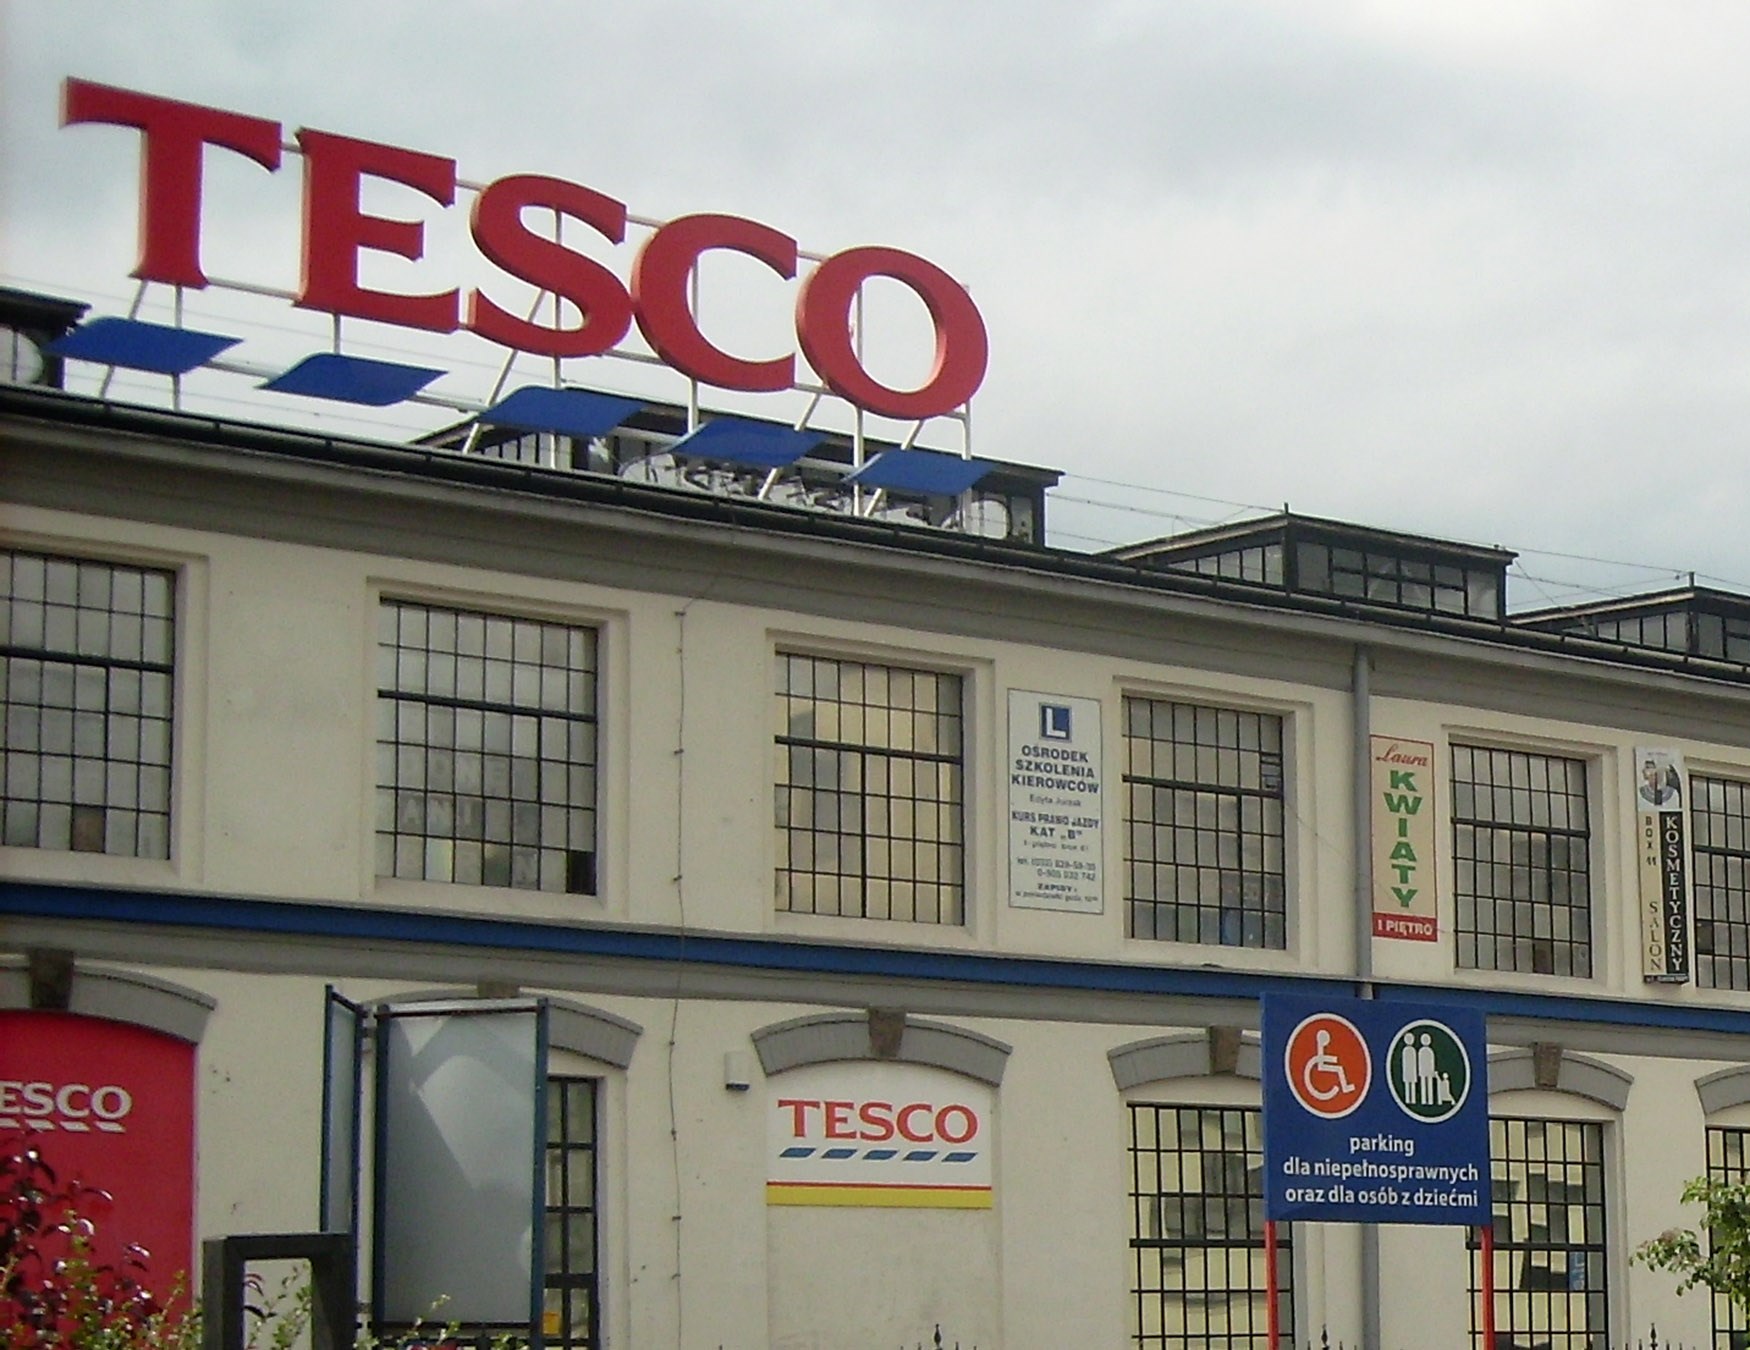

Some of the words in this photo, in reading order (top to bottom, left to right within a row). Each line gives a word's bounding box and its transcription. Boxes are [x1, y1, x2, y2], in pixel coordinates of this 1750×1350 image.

[59, 76, 988, 421] TESCO
[1015, 759, 1095, 778] SZKOLENIA
[1375, 743, 1428, 767] Laura
[1030, 826, 1055, 837] KAT
[1383, 769, 1422, 908] KWIATY
[1645, 815, 1655, 849] BOX
[1665, 815, 1683, 971] KOSMETYCZNY
[1377, 920, 1382, 931] I
[1649, 901, 1662, 971] SALON
[0, 1081, 132, 1119] ESCO
[777, 1098, 979, 1143] TESCO
[1349, 1134, 1415, 1157] parking
[1283, 1157, 1311, 1176] dla
[1314, 1158, 1479, 1185] niepełnosprawnych
[1285, 1188, 1325, 1203] oraz
[1328, 1185, 1355, 1204] dla
[1358, 1186, 1398, 1205] osób
[1401, 1191, 1411, 1205] z
[1413, 1187, 1479, 1208] dziećmi
